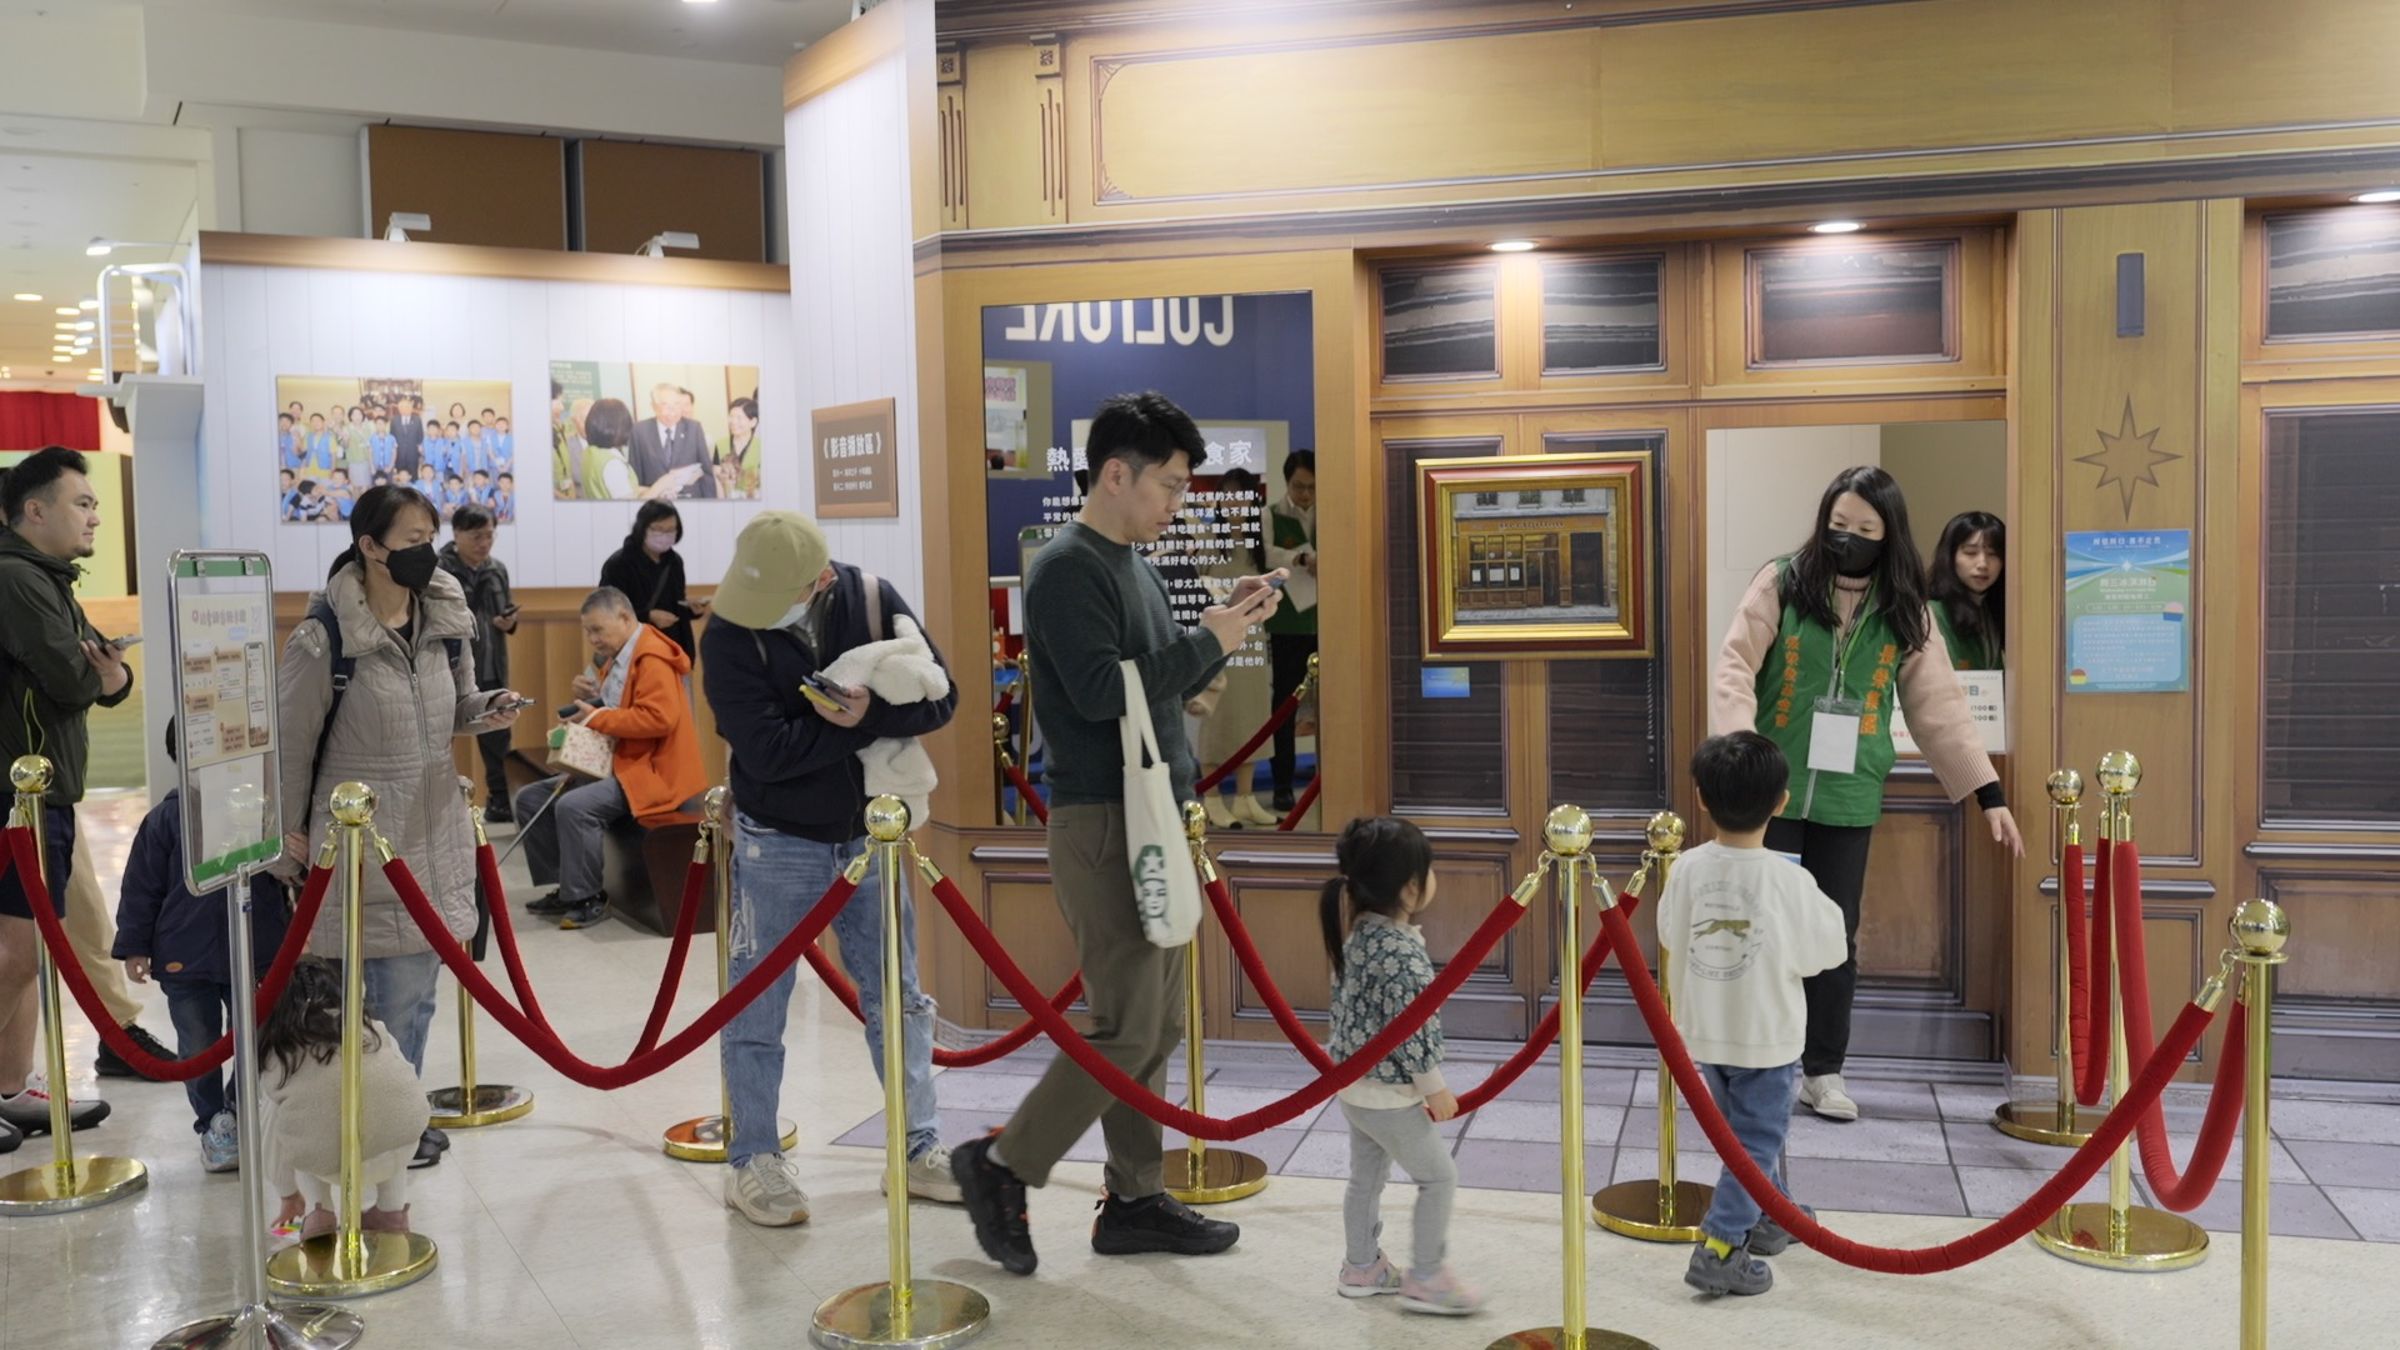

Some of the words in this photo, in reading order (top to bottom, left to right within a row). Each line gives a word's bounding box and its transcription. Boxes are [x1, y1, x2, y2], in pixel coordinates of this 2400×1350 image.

[1205, 440, 1253, 466] 食家
[1859, 643, 1897, 736] 長榮集團
